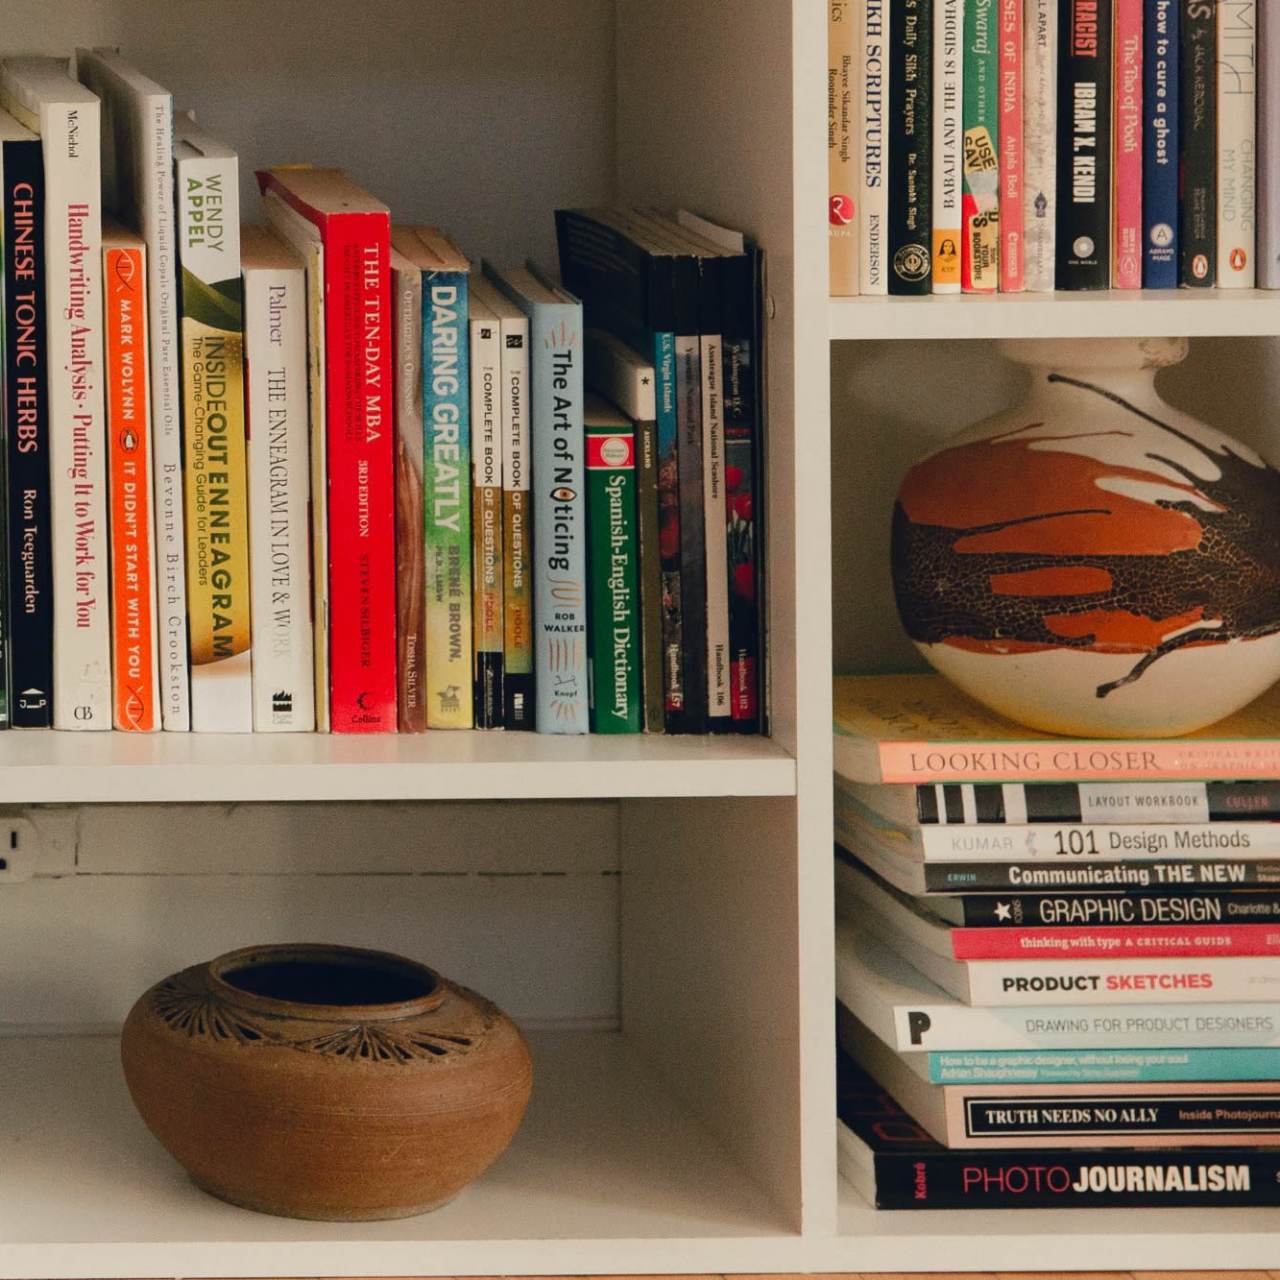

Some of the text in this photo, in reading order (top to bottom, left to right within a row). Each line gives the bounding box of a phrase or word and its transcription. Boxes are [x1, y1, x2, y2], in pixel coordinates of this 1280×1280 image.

[865, 44, 882, 188] SCRIPTURES
[1153, 1, 1170, 165] how to cure a ghost
[1073, 82, 1096, 203] IBRAM X. KENDI
[187, 177, 203, 248] APPEL
[205, 174, 224, 253] WENDY
[12, 182, 38, 453] CHINESE TONIC HERBS
[120, 298, 135, 421] MARK WOLYNN
[364, 243, 381, 443] THE TEN-DAY MBA
[430, 285, 460, 533] DARING GREATLY
[21, 489, 40, 615] Ron Teeguarden
[123, 461, 141, 679] IT DIDN'T START WITH YOU
[209, 471, 233, 658] ENNEAGRAM
[449, 545, 464, 597] BRENÉ
[608, 475, 630, 720] Spanish-English Dictionary
[544, 623, 586, 633] WALKER
[554, 612, 575, 621] ROB
[910, 751, 1161, 772] LOOKING CLOSER
[1008, 865, 1246, 885] Communicating THE NEW
[1054, 829, 1251, 855] 101 Design Methods
[1040, 898, 1221, 922] GRAPHIC DESIGN
[1002, 973, 1213, 992] PRODUCT SKETCHES
[985, 1108, 1158, 1124] TRUTH NEEDS NO ALLY
